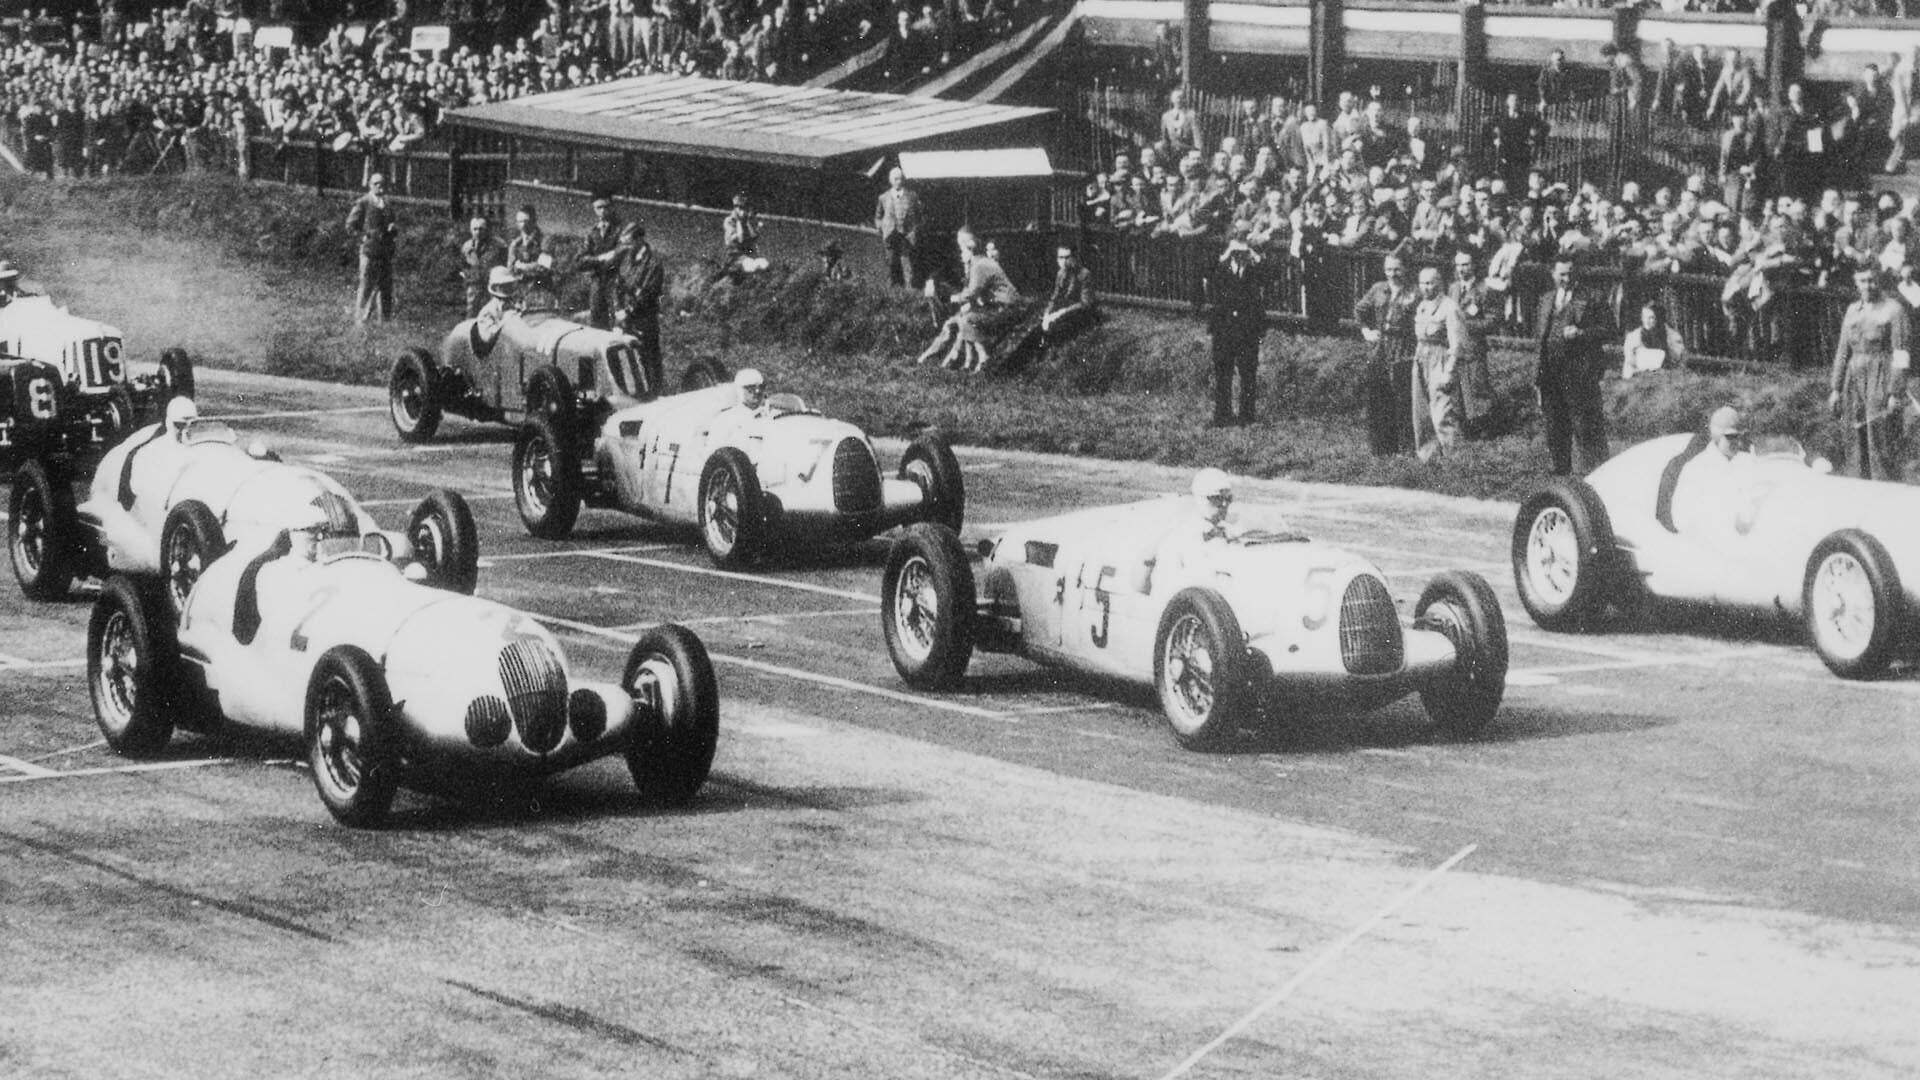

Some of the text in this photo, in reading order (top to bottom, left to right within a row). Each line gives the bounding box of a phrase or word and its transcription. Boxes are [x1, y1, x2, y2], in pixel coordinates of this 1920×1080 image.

[90, 340, 125, 384] 19
[29, 377, 57, 419] 8
[664, 442, 681, 504] 7
[289, 585, 340, 653] 2
[1090, 565, 1117, 648] 5
[1302, 566, 1337, 631] 5
